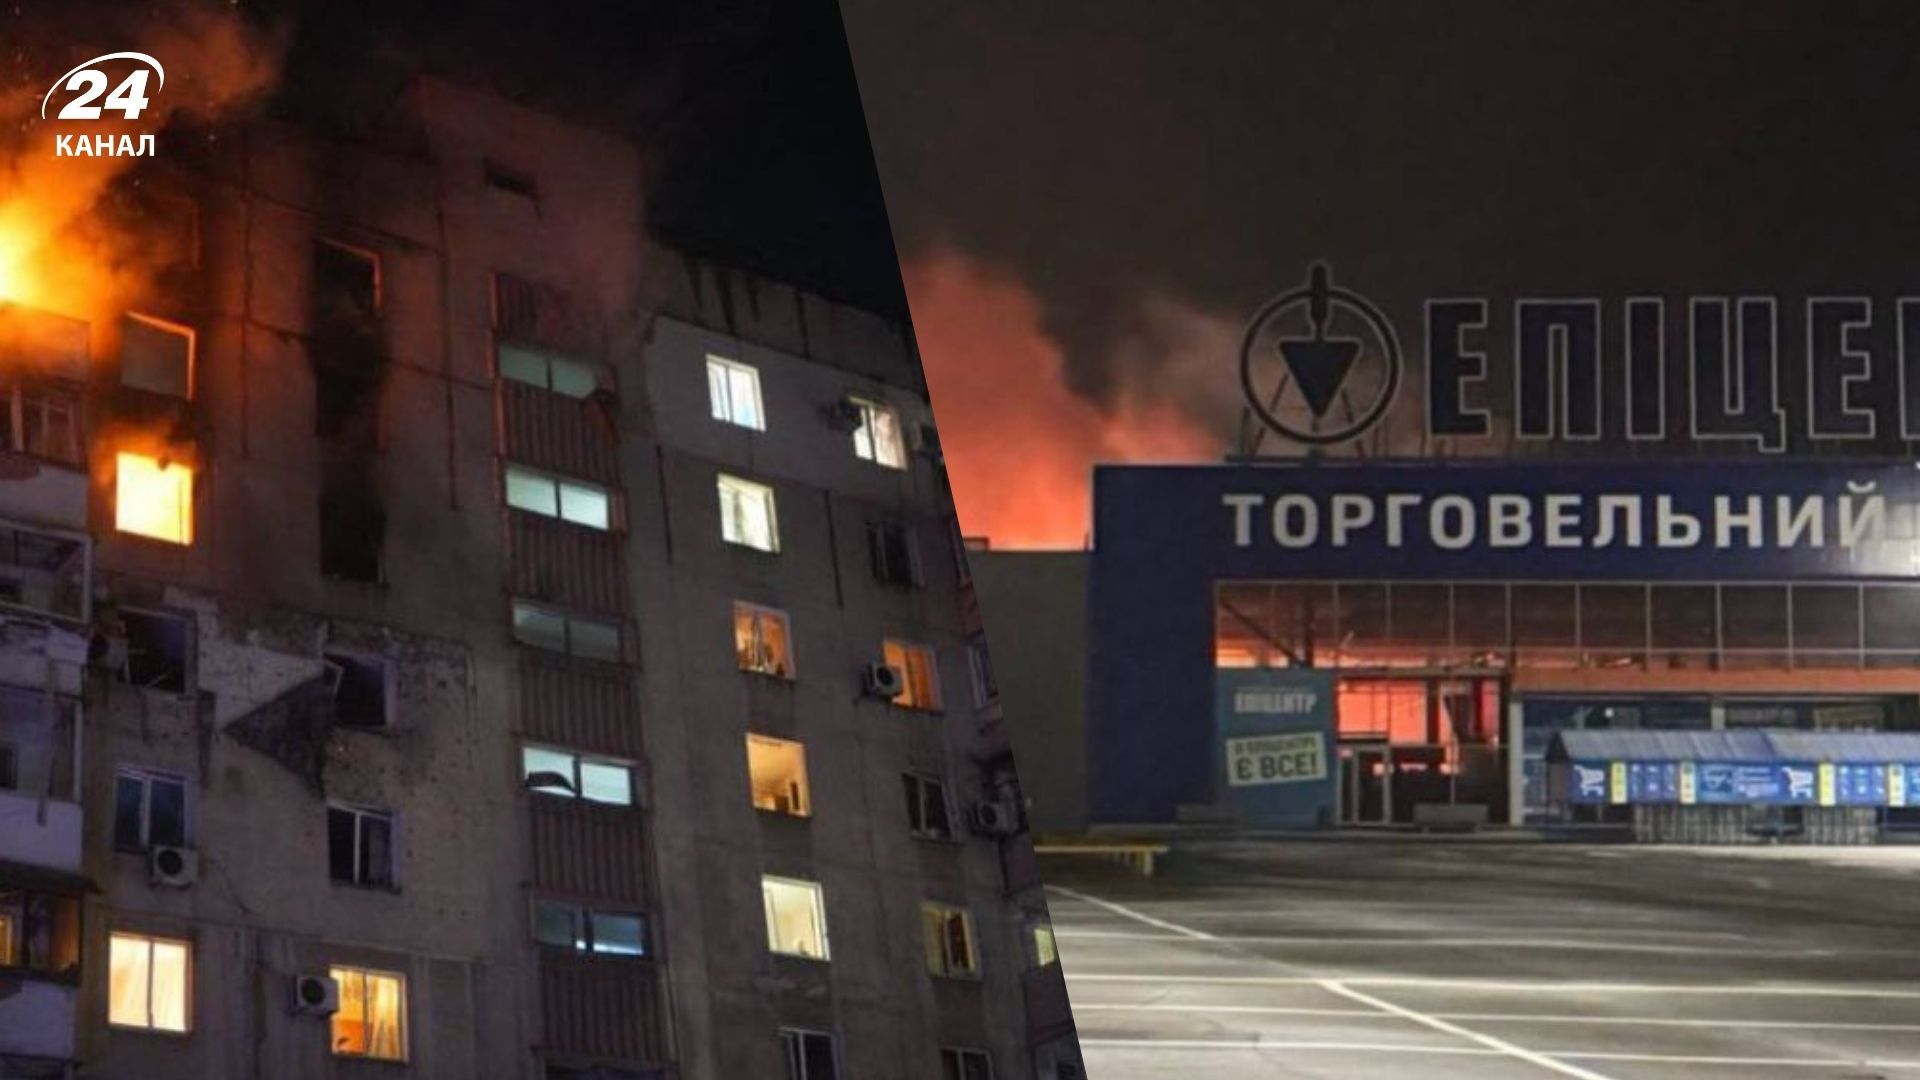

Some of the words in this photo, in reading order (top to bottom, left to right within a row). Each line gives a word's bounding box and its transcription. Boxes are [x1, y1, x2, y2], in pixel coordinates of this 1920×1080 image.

[1423, 299, 1920, 453] ЕПІЦЕ
[1222, 481, 1887, 549] ТОРГОВЕЛЬНИЙ
[1237, 756, 1253, 780] Є
[1261, 754, 1319, 779] ВСЕ!
